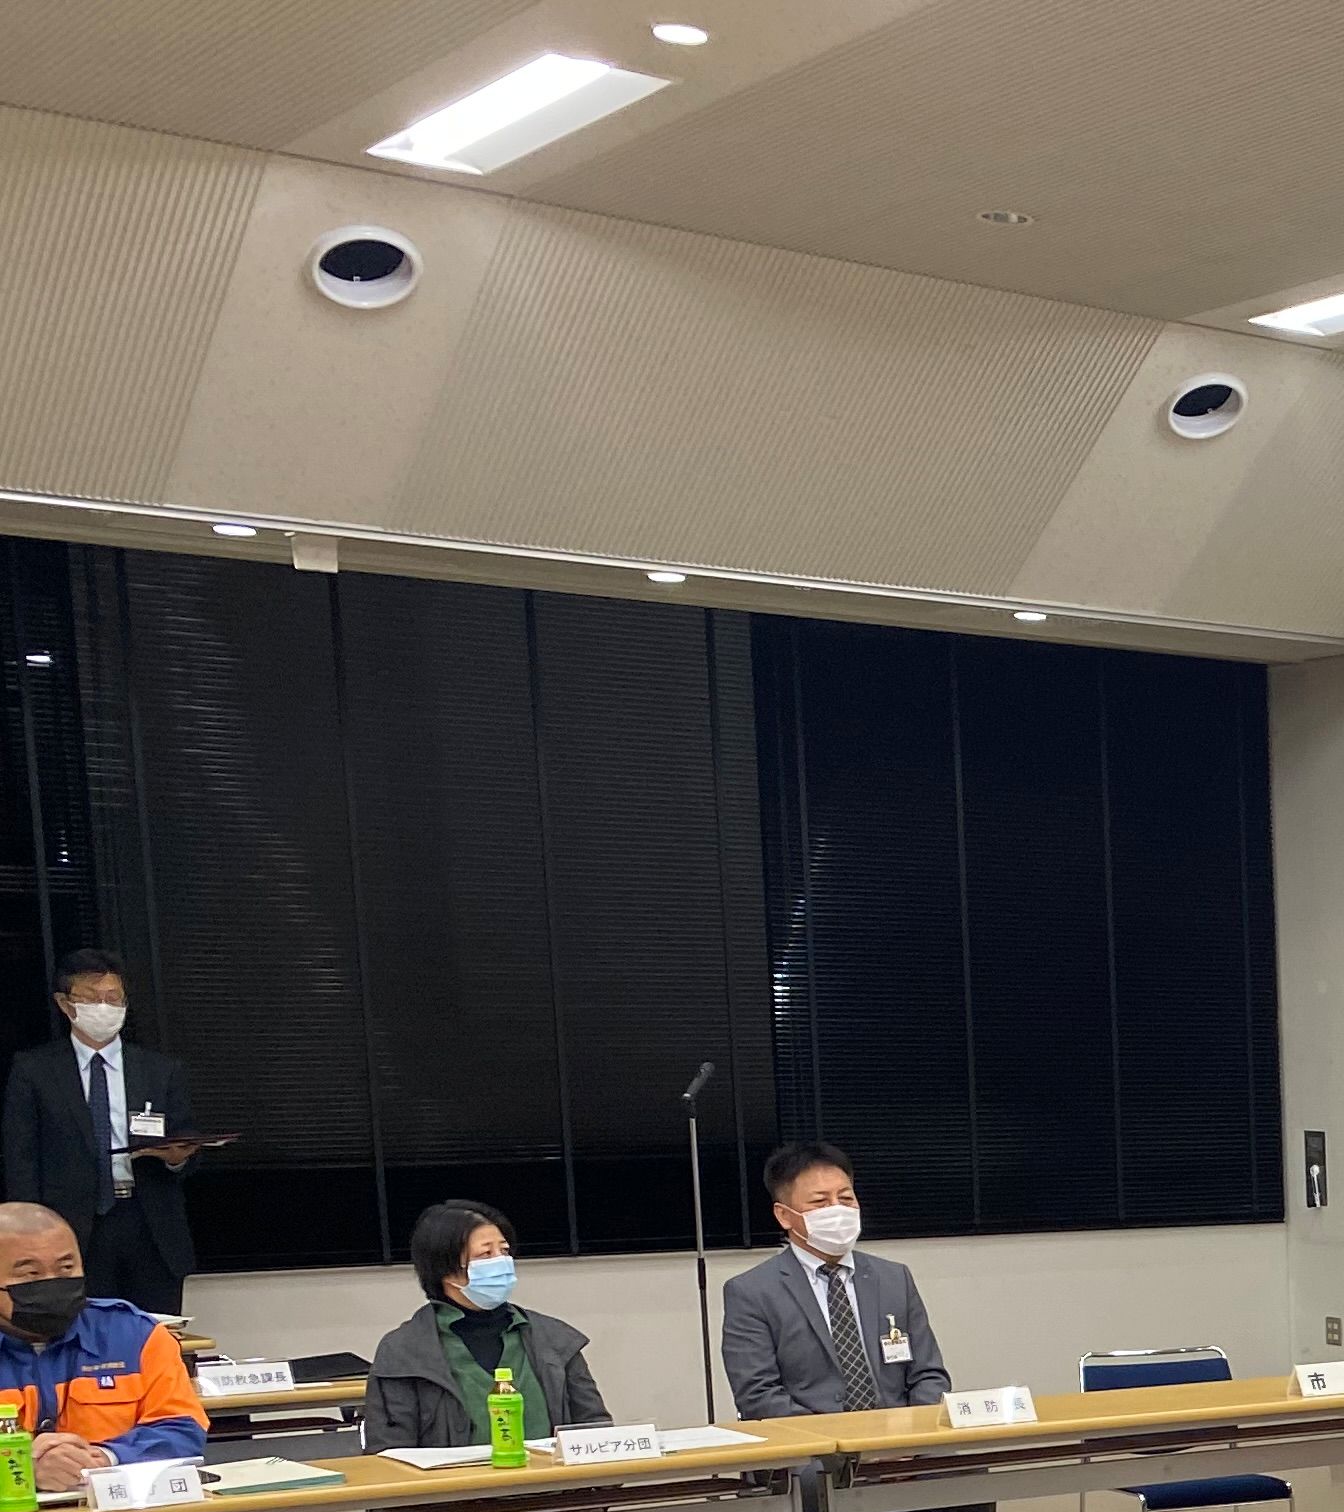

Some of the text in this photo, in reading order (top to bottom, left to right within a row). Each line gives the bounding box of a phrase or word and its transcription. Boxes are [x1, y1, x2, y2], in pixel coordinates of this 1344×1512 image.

[957, 1397, 1026, 1415] 消防長
[570, 1437, 652, 1456] サルビア分団
[107, 1478, 188, 1500] 楠団
